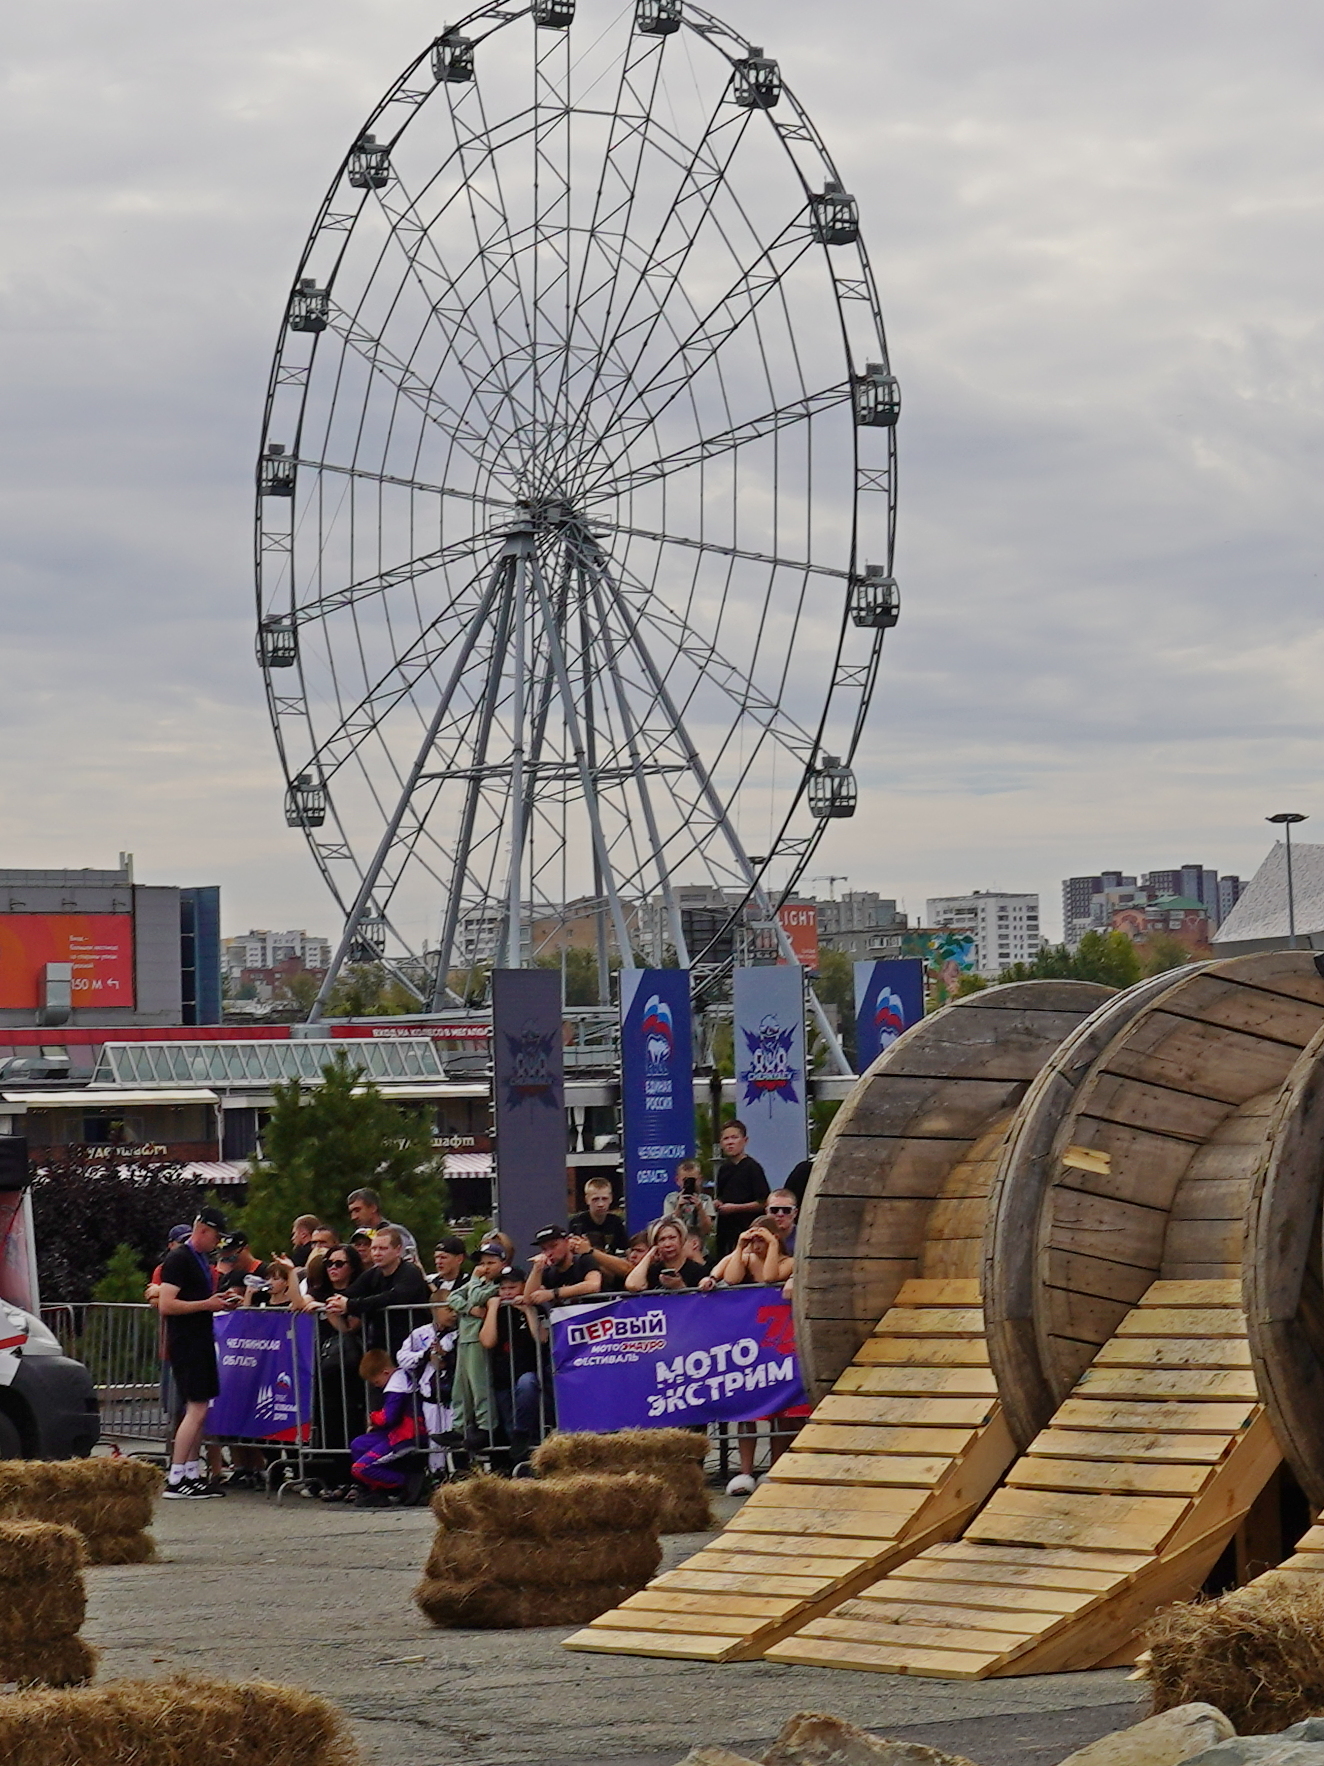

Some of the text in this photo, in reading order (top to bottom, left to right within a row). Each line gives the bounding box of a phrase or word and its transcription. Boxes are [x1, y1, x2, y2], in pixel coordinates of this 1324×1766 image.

[645, 1096, 673, 1110] РОССИЯ
[570, 1312, 665, 1344] ПЕРВЫЙ
[573, 1353, 640, 1367] ФЕСТИВАЛЬ
[655, 1338, 759, 1389] МОТО
[647, 1356, 794, 1417] ЭКСТРИМ
